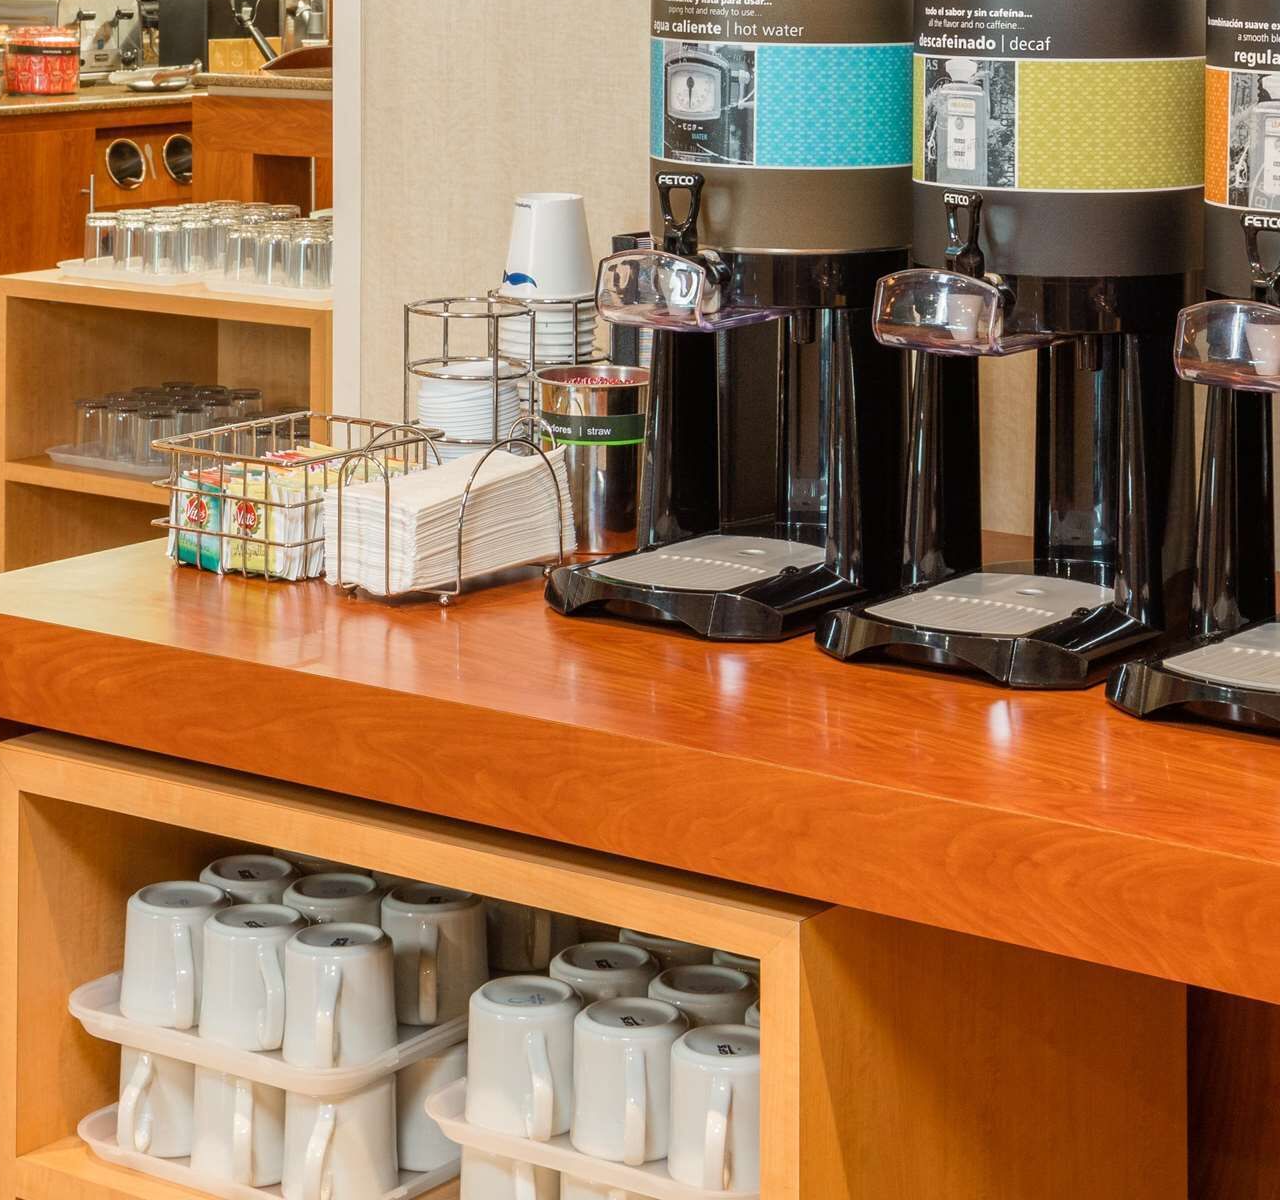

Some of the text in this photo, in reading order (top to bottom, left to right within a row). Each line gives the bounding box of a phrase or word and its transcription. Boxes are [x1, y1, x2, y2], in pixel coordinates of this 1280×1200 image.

[684, 5, 695, 15] hot
[695, 6, 708, 15] and
[709, 6, 729, 17] ready
[731, 8, 740, 16] to
[741, 9, 762, 17] use...
[938, 6, 944, 16] el
[945, 7, 966, 17] sabor
[967, 10, 973, 18] y
[974, 8, 987, 17] sin
[653, 19, 804, 37] agua caliente hot water
[943, 18, 960, 28] flavor
[960, 19, 974, 29] and
[975, 21, 985, 29] no
[986, 20, 1025, 30] caffeine...
[1244, 21, 1269, 30] suave
[919, 32, 1052, 51] descafeinado decaf
[1243, 33, 1269, 42] smooth
[658, 175, 694, 185] FETCO
[944, 193, 969, 205] FETCO
[586, 427, 611, 435] straw
